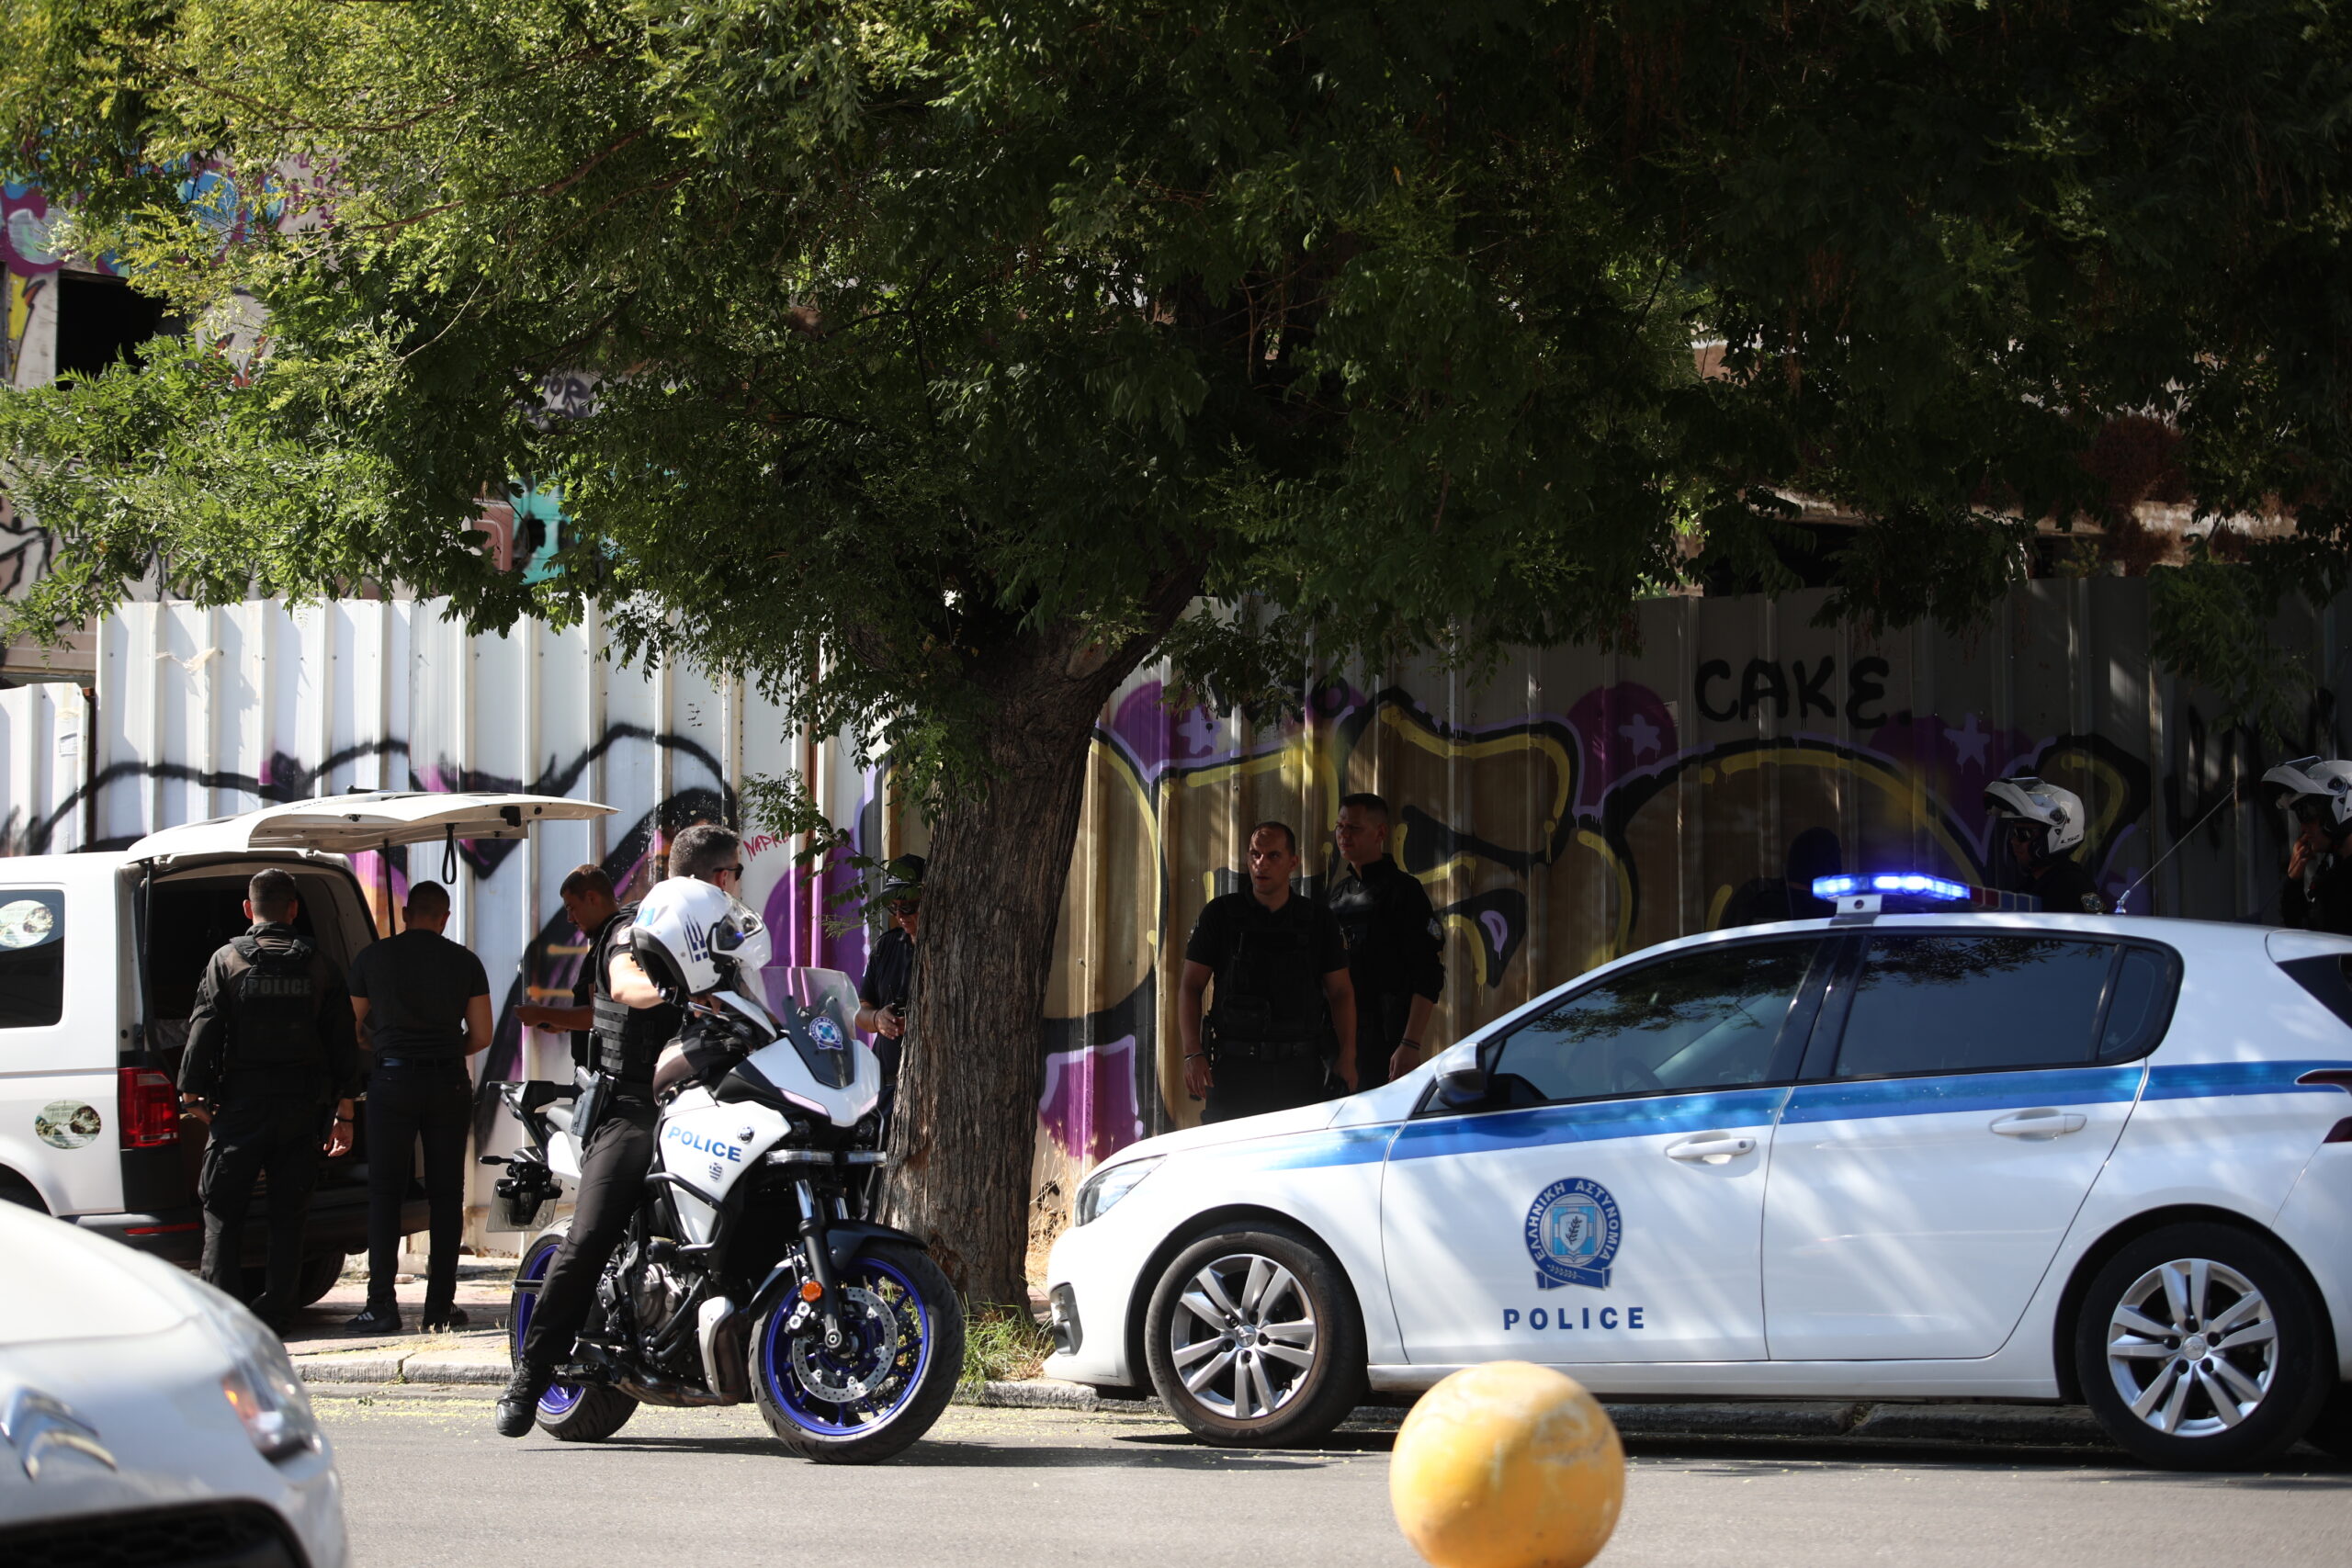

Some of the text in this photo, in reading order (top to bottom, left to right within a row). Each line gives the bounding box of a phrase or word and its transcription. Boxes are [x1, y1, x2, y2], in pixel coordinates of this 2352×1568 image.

[247, 978, 311, 995] POLICE
[667, 1126, 742, 1163] POLICE
[1527, 1179, 1620, 1262] ΕΛΛΗΝΙΚΗ ΑΣΤΥΝΟΜΙΑ
[1503, 1307, 1645, 1330] POLICE
